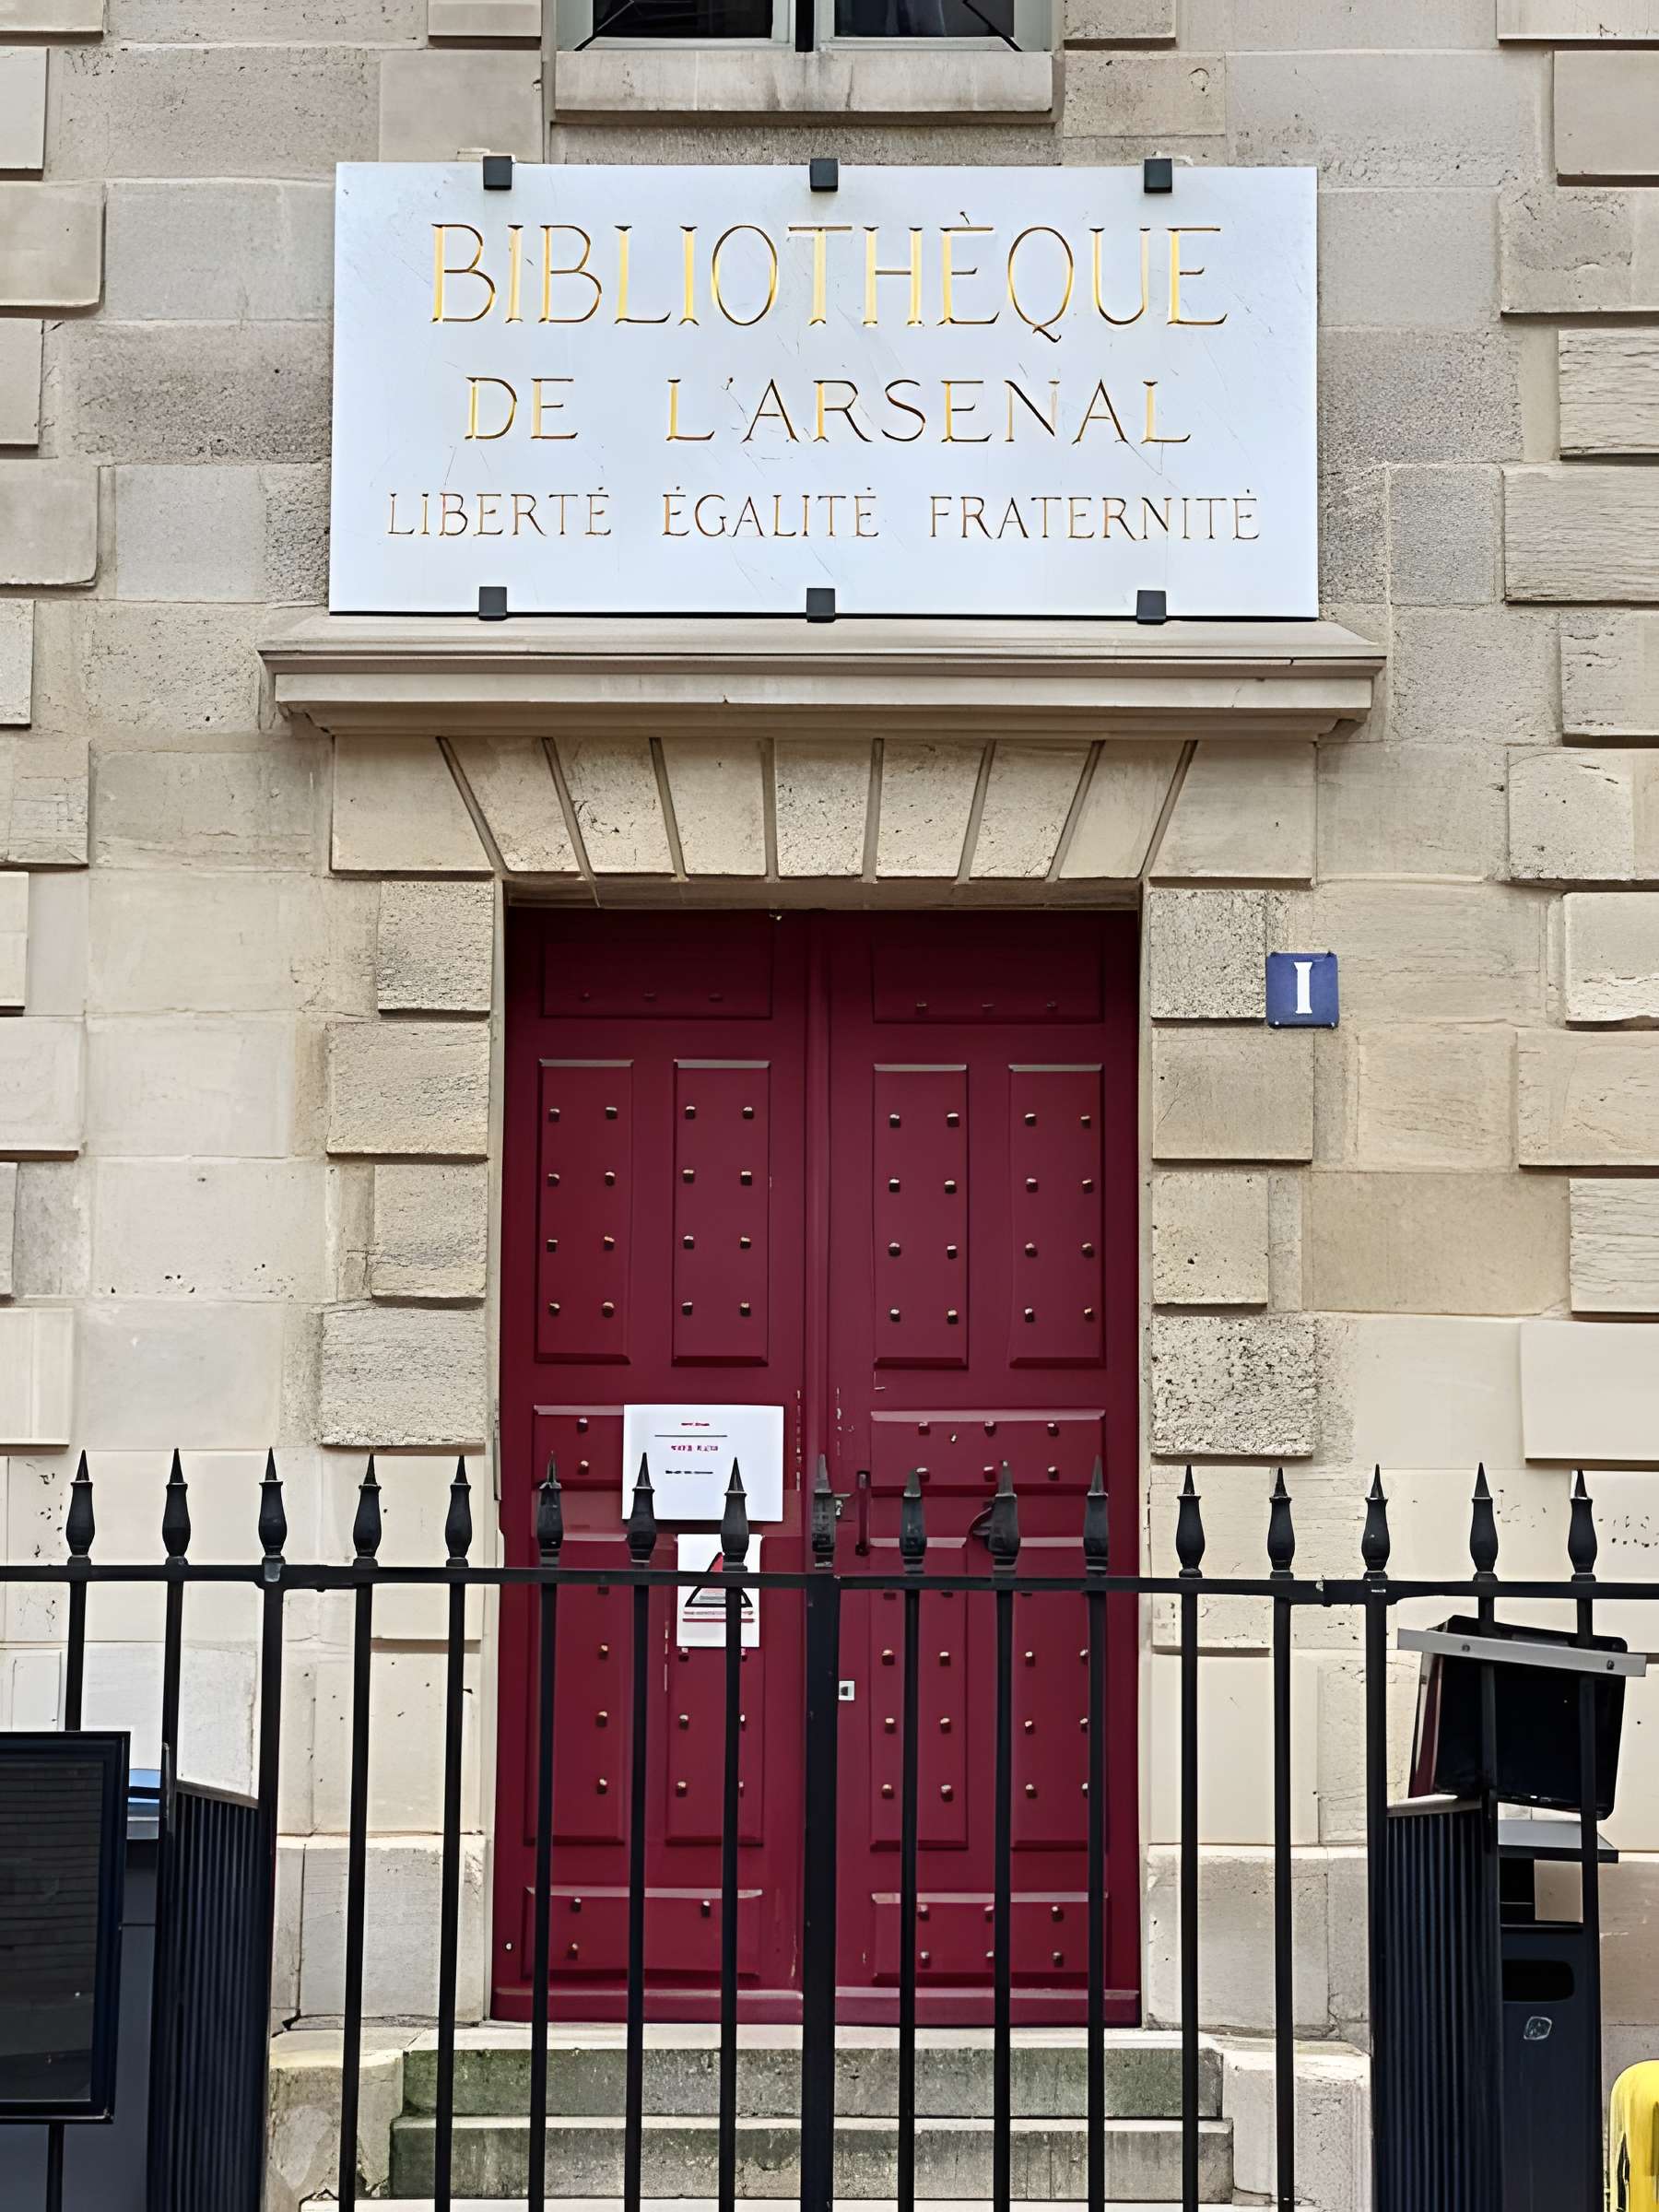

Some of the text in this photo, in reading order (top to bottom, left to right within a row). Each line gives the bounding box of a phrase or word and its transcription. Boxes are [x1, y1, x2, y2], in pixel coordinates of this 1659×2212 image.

[430, 211, 1228, 343] BIBLIOTHÈQUE
[465, 376, 1192, 444] DE L'ARSENAL
[387, 485, 1261, 541] LIBERTÉ ÉGALITÉ FRATERNITÉ
